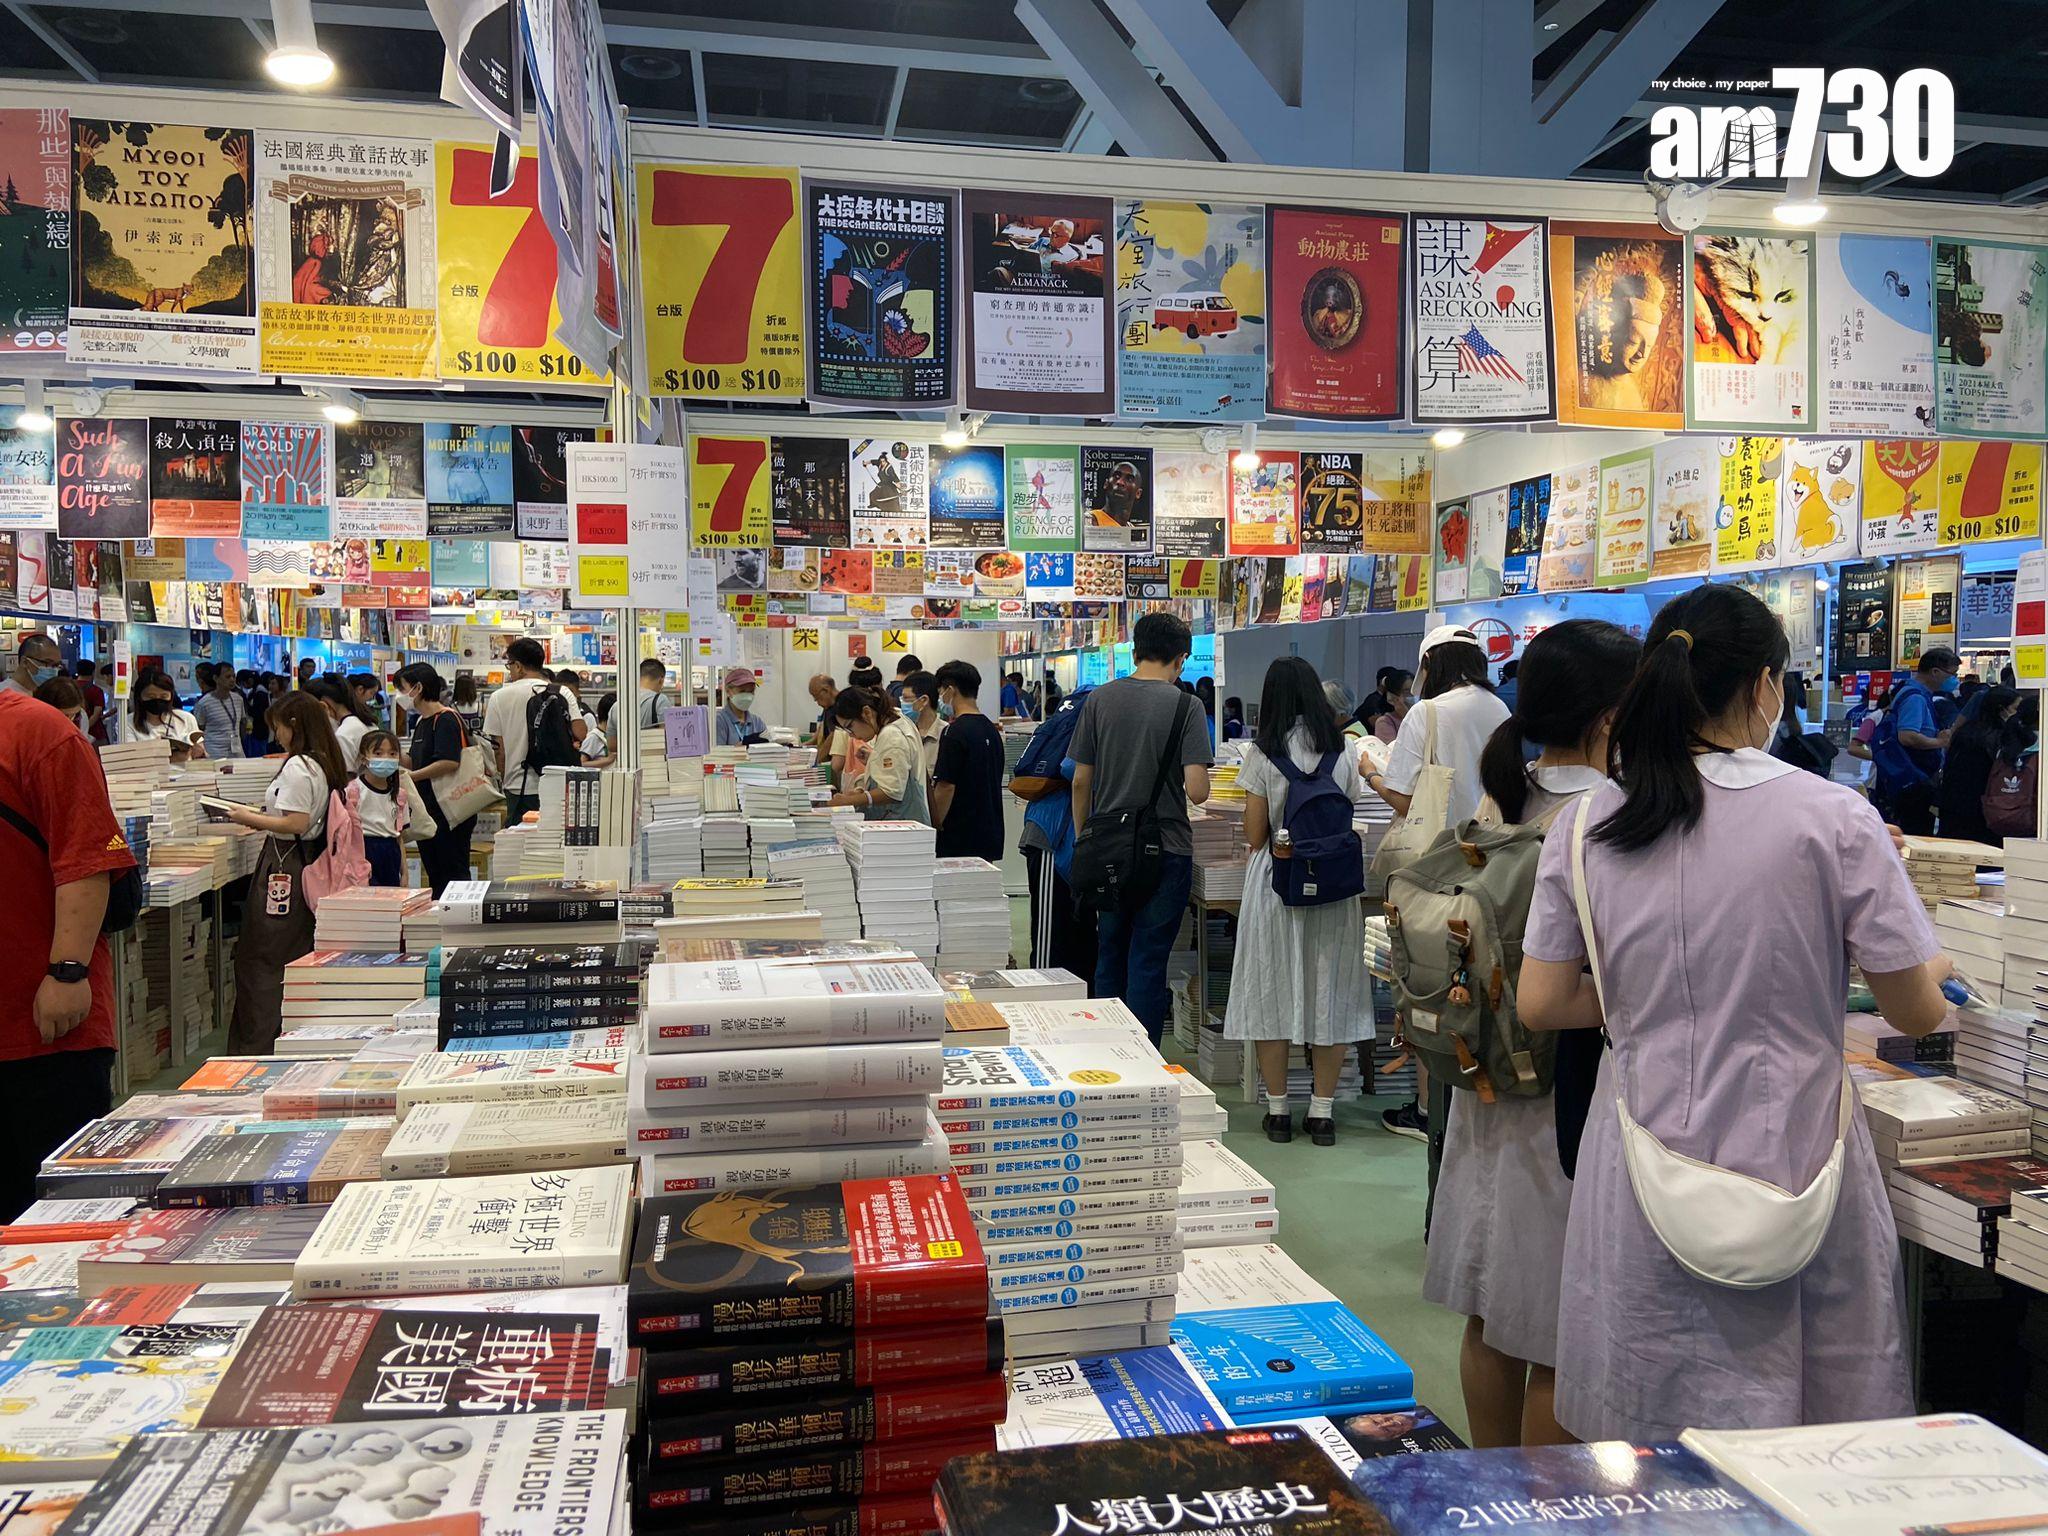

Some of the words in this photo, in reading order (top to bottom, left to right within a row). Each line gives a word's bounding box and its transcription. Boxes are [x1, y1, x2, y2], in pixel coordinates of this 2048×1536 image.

[264, 139, 429, 167] 法國經典童話故事
[817, 193, 945, 225] 大疫年代十日談
[124, 228, 206, 247] 伊索寓言
[1297, 237, 1369, 262] 動物農莊
[1418, 221, 1471, 278] 謀
[652, 170, 794, 365] 7
[451, 284, 479, 298] 台版
[1010, 278, 1069, 289] ALMANACK
[656, 303, 683, 317] 台版
[990, 299, 1090, 314] 窮查理的普通常識
[1419, 299, 1542, 319] RECKONING
[766, 313, 787, 326] 折起
[1419, 335, 1471, 393] 算
[68, 420, 120, 451] Such
[244, 426, 285, 439] BRAVE
[290, 428, 316, 440] NEW
[345, 424, 414, 438] CHOOSE
[459, 426, 478, 439] THE
[155, 432, 236, 452] 殺人預告
[245, 440, 294, 453] WORLD
[428, 438, 511, 454] MOTHER-IN-LAW
[1084, 449, 1109, 460] Kobe
[1084, 459, 1115, 470] Bryant
[1320, 455, 1352, 469] NBA
[630, 467, 648, 480] 7折
[774, 456, 786, 510] 做了什麼
[789, 477, 800, 490] 你
[804, 462, 816, 502] 那一天
[909, 446, 925, 510] 武術的科學
[1946, 474, 1963, 485] 台版
[697, 437, 767, 533] 7
[1310, 487, 1359, 526] 75
[631, 520, 650, 532] 8折
[1014, 515, 1056, 525] SCIENCE
[1058, 516, 1073, 525] OF
[1014, 526, 1074, 536] RUNNING
[1868, 529, 1886, 540] 小孩
[632, 570, 650, 584] 9折
[721, 1015, 787, 1032] 親愛的股東
[718, 1067, 784, 1084] 親愛的股東
[700, 1118, 767, 1135] 親愛的股東
[726, 1167, 793, 1184] 親愛的股東
[467, 1194, 519, 1238] 衝擊
[511, 1174, 572, 1254] 多極世界
[567, 1184, 594, 1239] LEVELLING
[591, 1201, 608, 1221] THE
[713, 1295, 822, 1324] 漫步華爾街
[362, 1321, 474, 1414] 美國
[732, 1352, 840, 1380] 漫步華爾街
[574, 1413, 607, 1442] THE
[735, 1411, 844, 1440] 漫步華爾街
[512, 1416, 565, 1513] KNOWLEDGE
[723, 1464, 832, 1493] 漫步華爾街
[552, 1446, 602, 1536] FRONTIERS
[1818, 1482, 1913, 1508] FAST
[1052, 1481, 1326, 1536] 人類大歷史
[1445, 1487, 1746, 1531] 21世紀的21堂課
